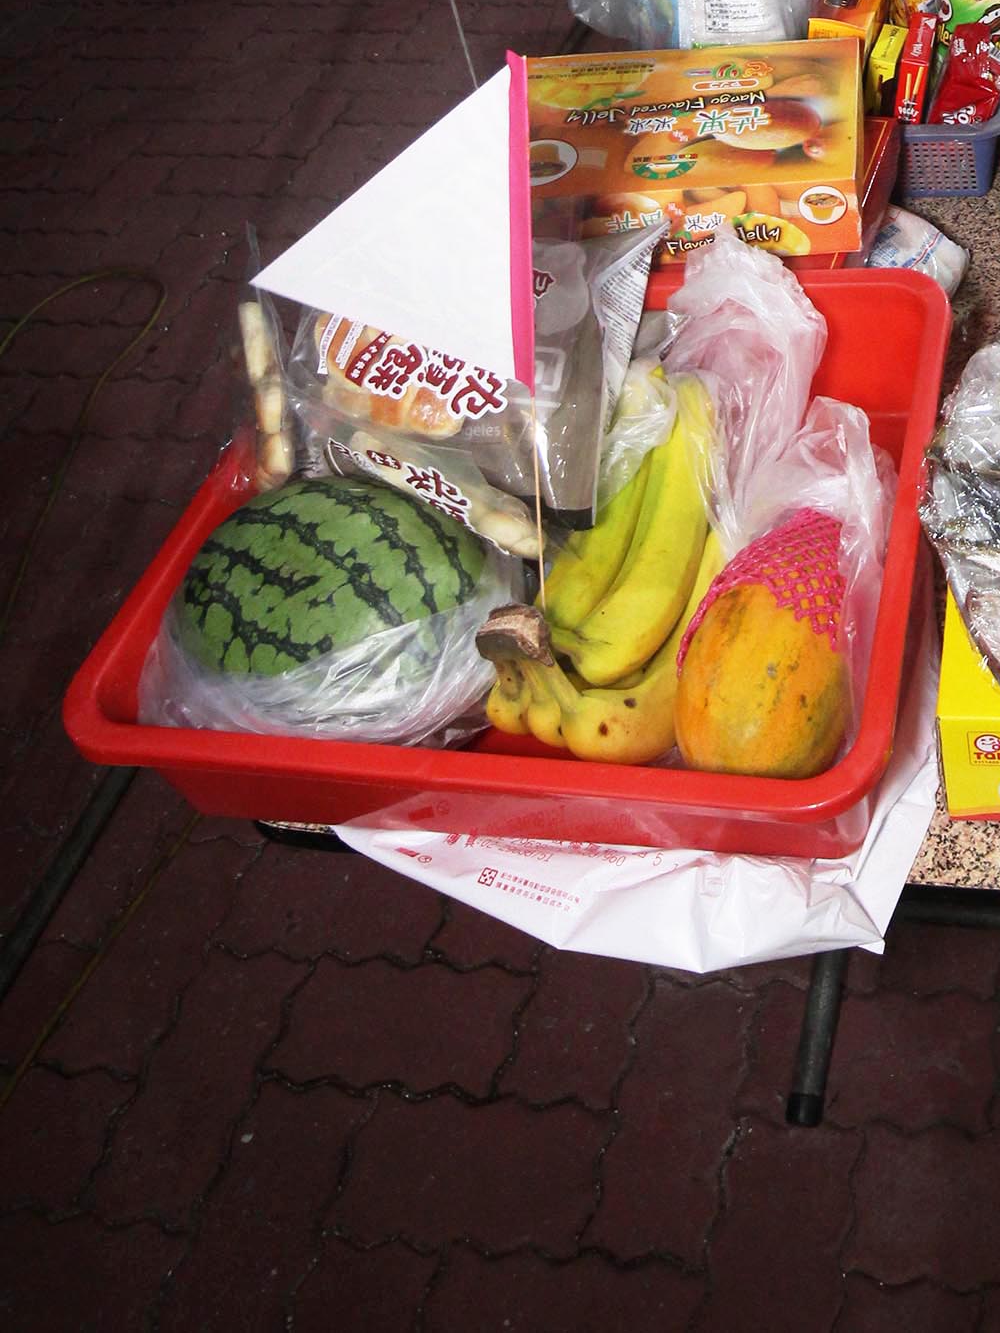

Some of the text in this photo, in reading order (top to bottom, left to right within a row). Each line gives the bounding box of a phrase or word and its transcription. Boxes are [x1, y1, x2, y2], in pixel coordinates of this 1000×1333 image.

[567, 90, 766, 126] Mango Flavored Jelly
[694, 106, 771, 136] 芒果
